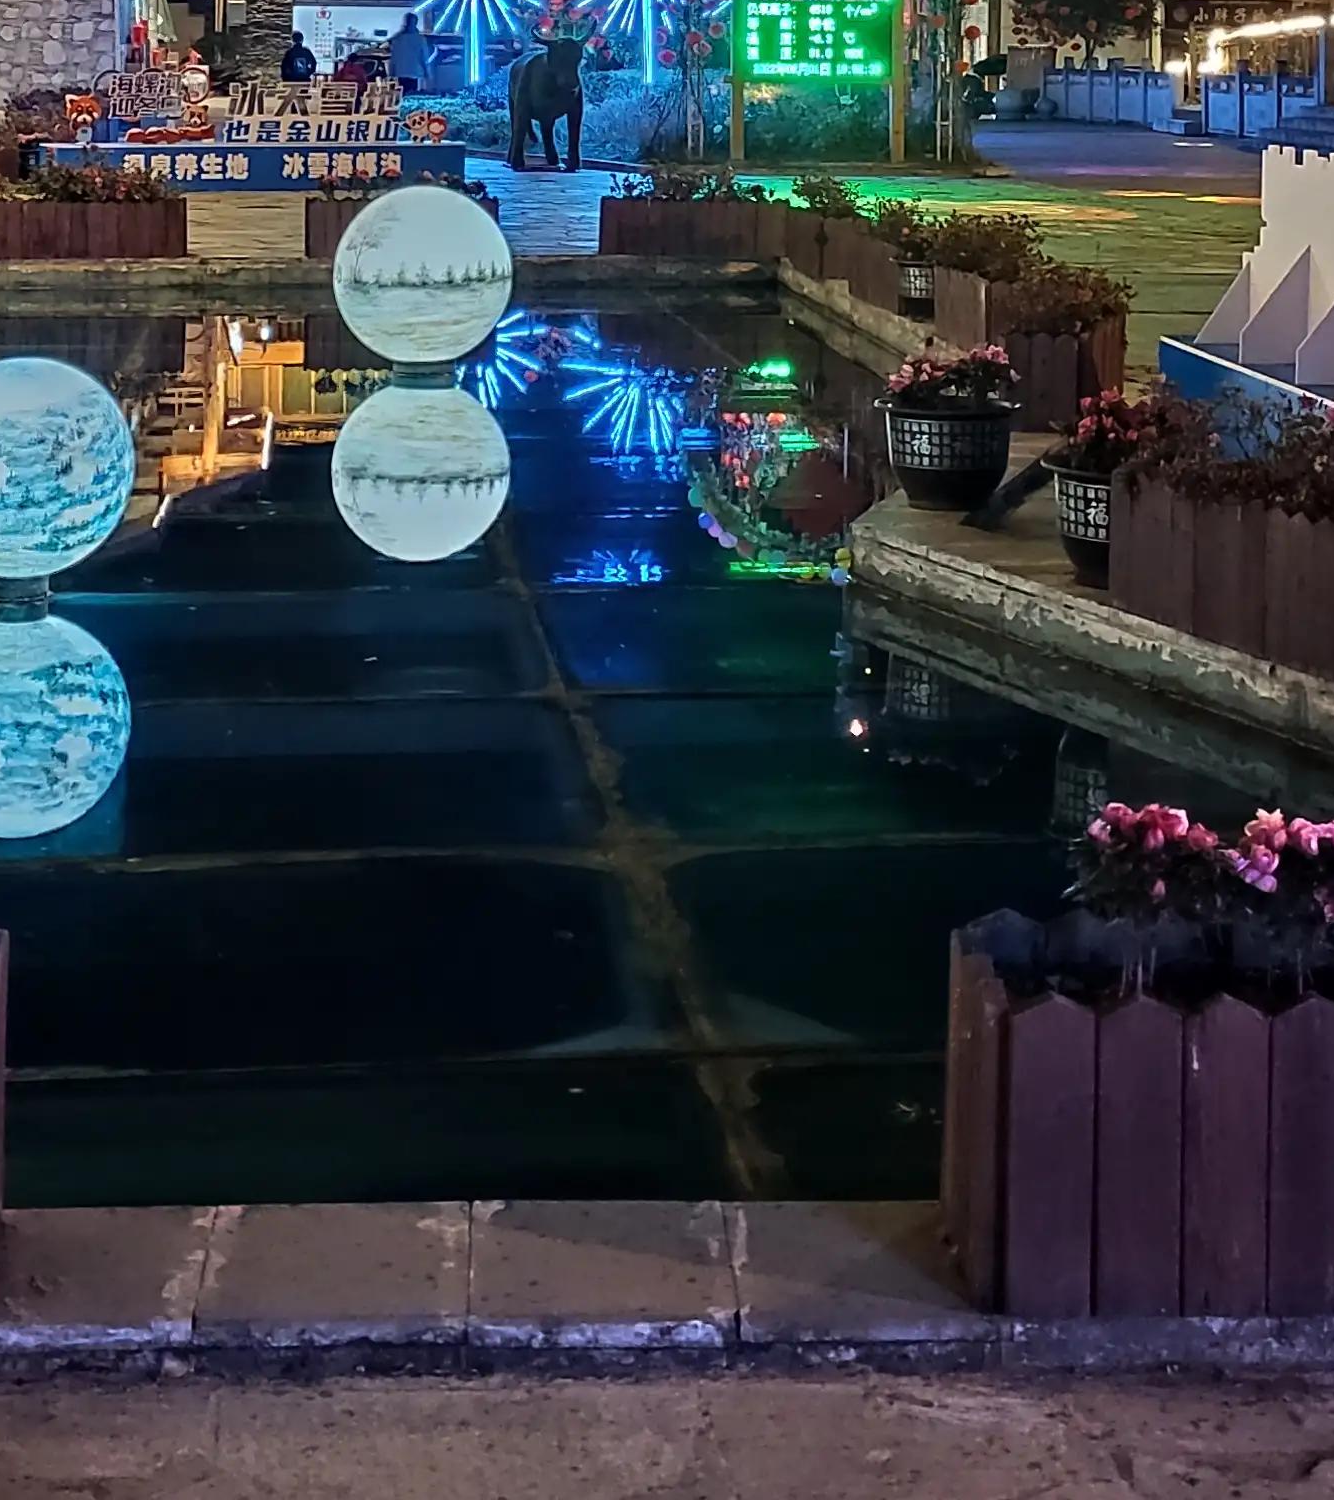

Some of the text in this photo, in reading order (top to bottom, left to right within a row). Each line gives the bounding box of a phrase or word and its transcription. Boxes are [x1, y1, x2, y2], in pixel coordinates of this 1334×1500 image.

[227, 81, 403, 117] 冰天雪地
[223, 118, 402, 144] 也是金山银山
[282, 152, 403, 180] 冰雪海螺沟
[1086, 501, 1109, 526] 福
